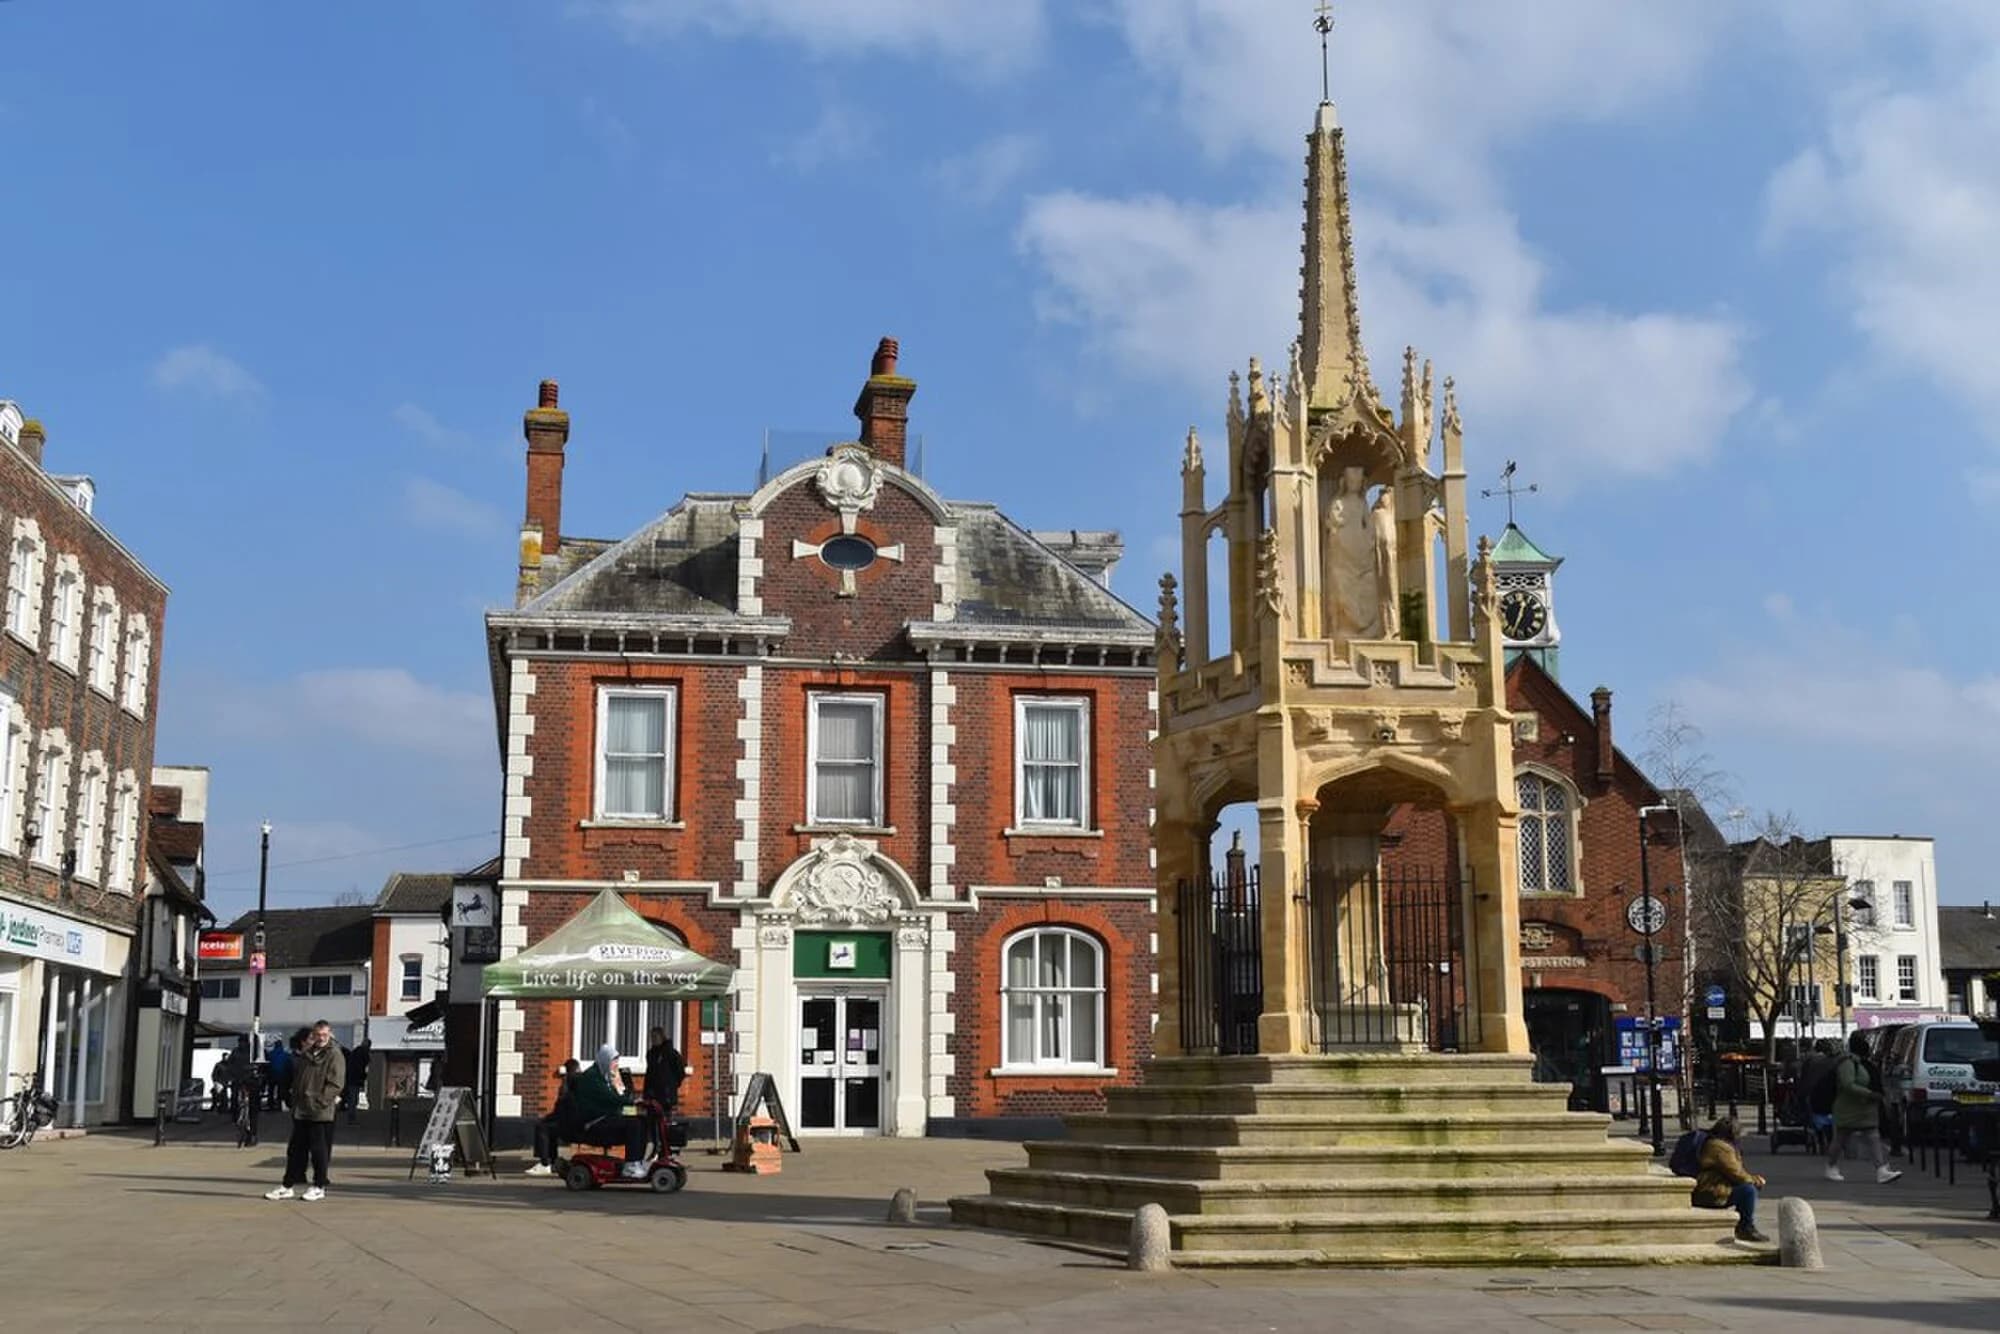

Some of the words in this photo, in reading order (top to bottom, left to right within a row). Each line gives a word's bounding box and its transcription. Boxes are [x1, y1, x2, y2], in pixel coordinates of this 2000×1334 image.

[522, 969, 560, 987] Live
[565, 968, 598, 991] life
[602, 972, 625, 985] on
[632, 970, 660, 985] the
[668, 972, 699, 991] veg
